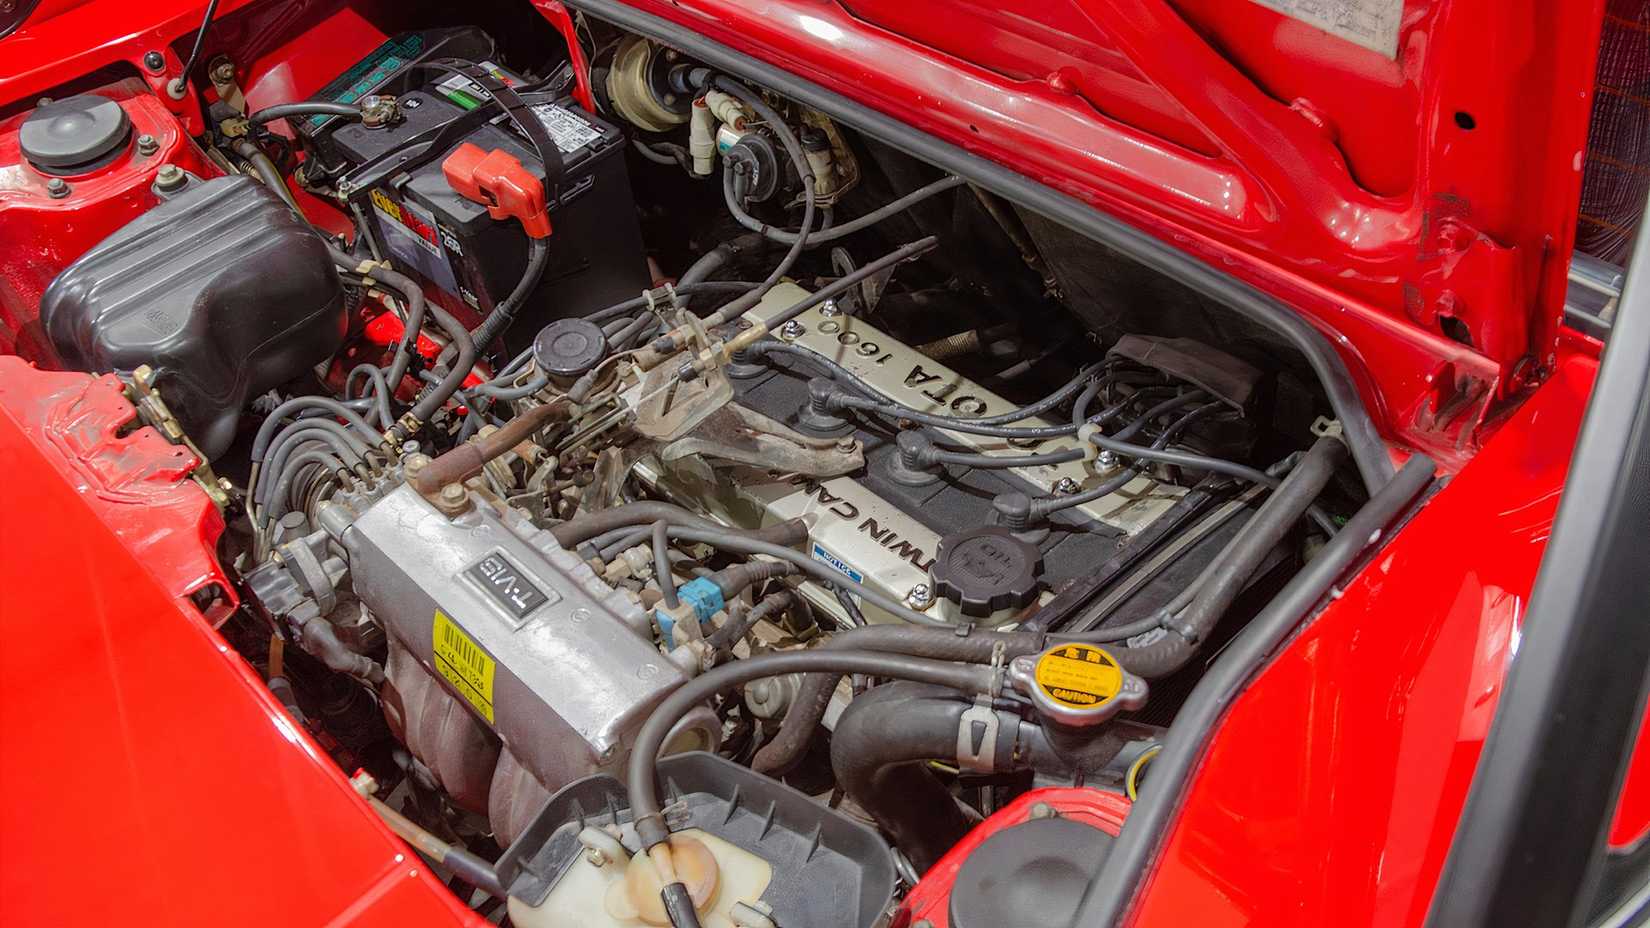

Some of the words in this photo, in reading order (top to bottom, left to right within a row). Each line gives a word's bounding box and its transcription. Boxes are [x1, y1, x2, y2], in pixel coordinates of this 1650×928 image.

[816, 320, 894, 368] 1600
[857, 517, 937, 574] TWIN
[1051, 687, 1097, 704] CAUTION
